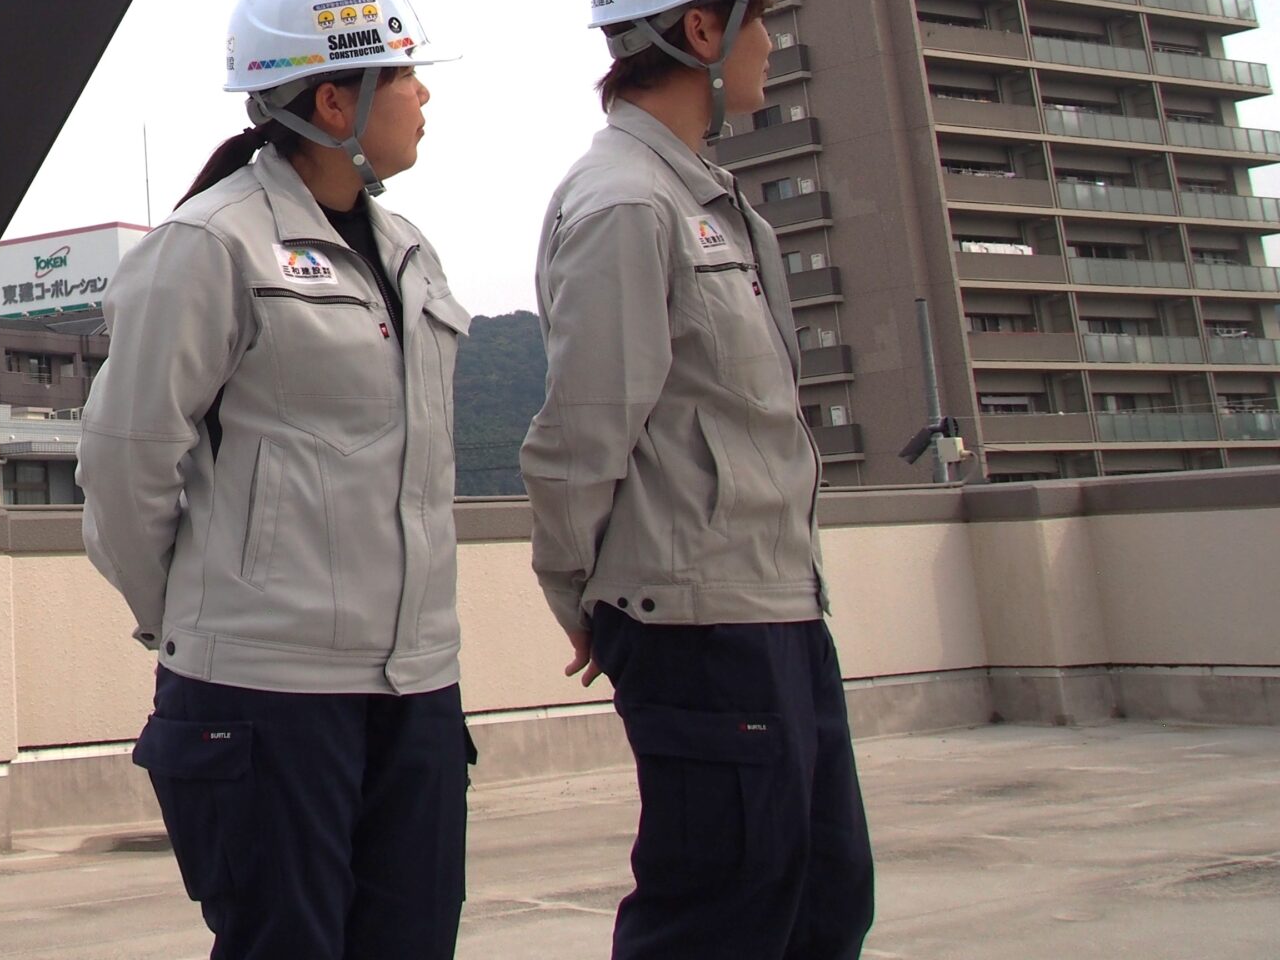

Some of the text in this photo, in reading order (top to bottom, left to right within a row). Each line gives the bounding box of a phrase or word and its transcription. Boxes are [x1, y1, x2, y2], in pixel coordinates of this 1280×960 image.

[328, 29, 382, 50] SANWA
[329, 45, 385, 60] CONSTRUCTION
[34, 255, 67, 270] TOKEN
[2, 276, 108, 306] 東建コーポレーション
